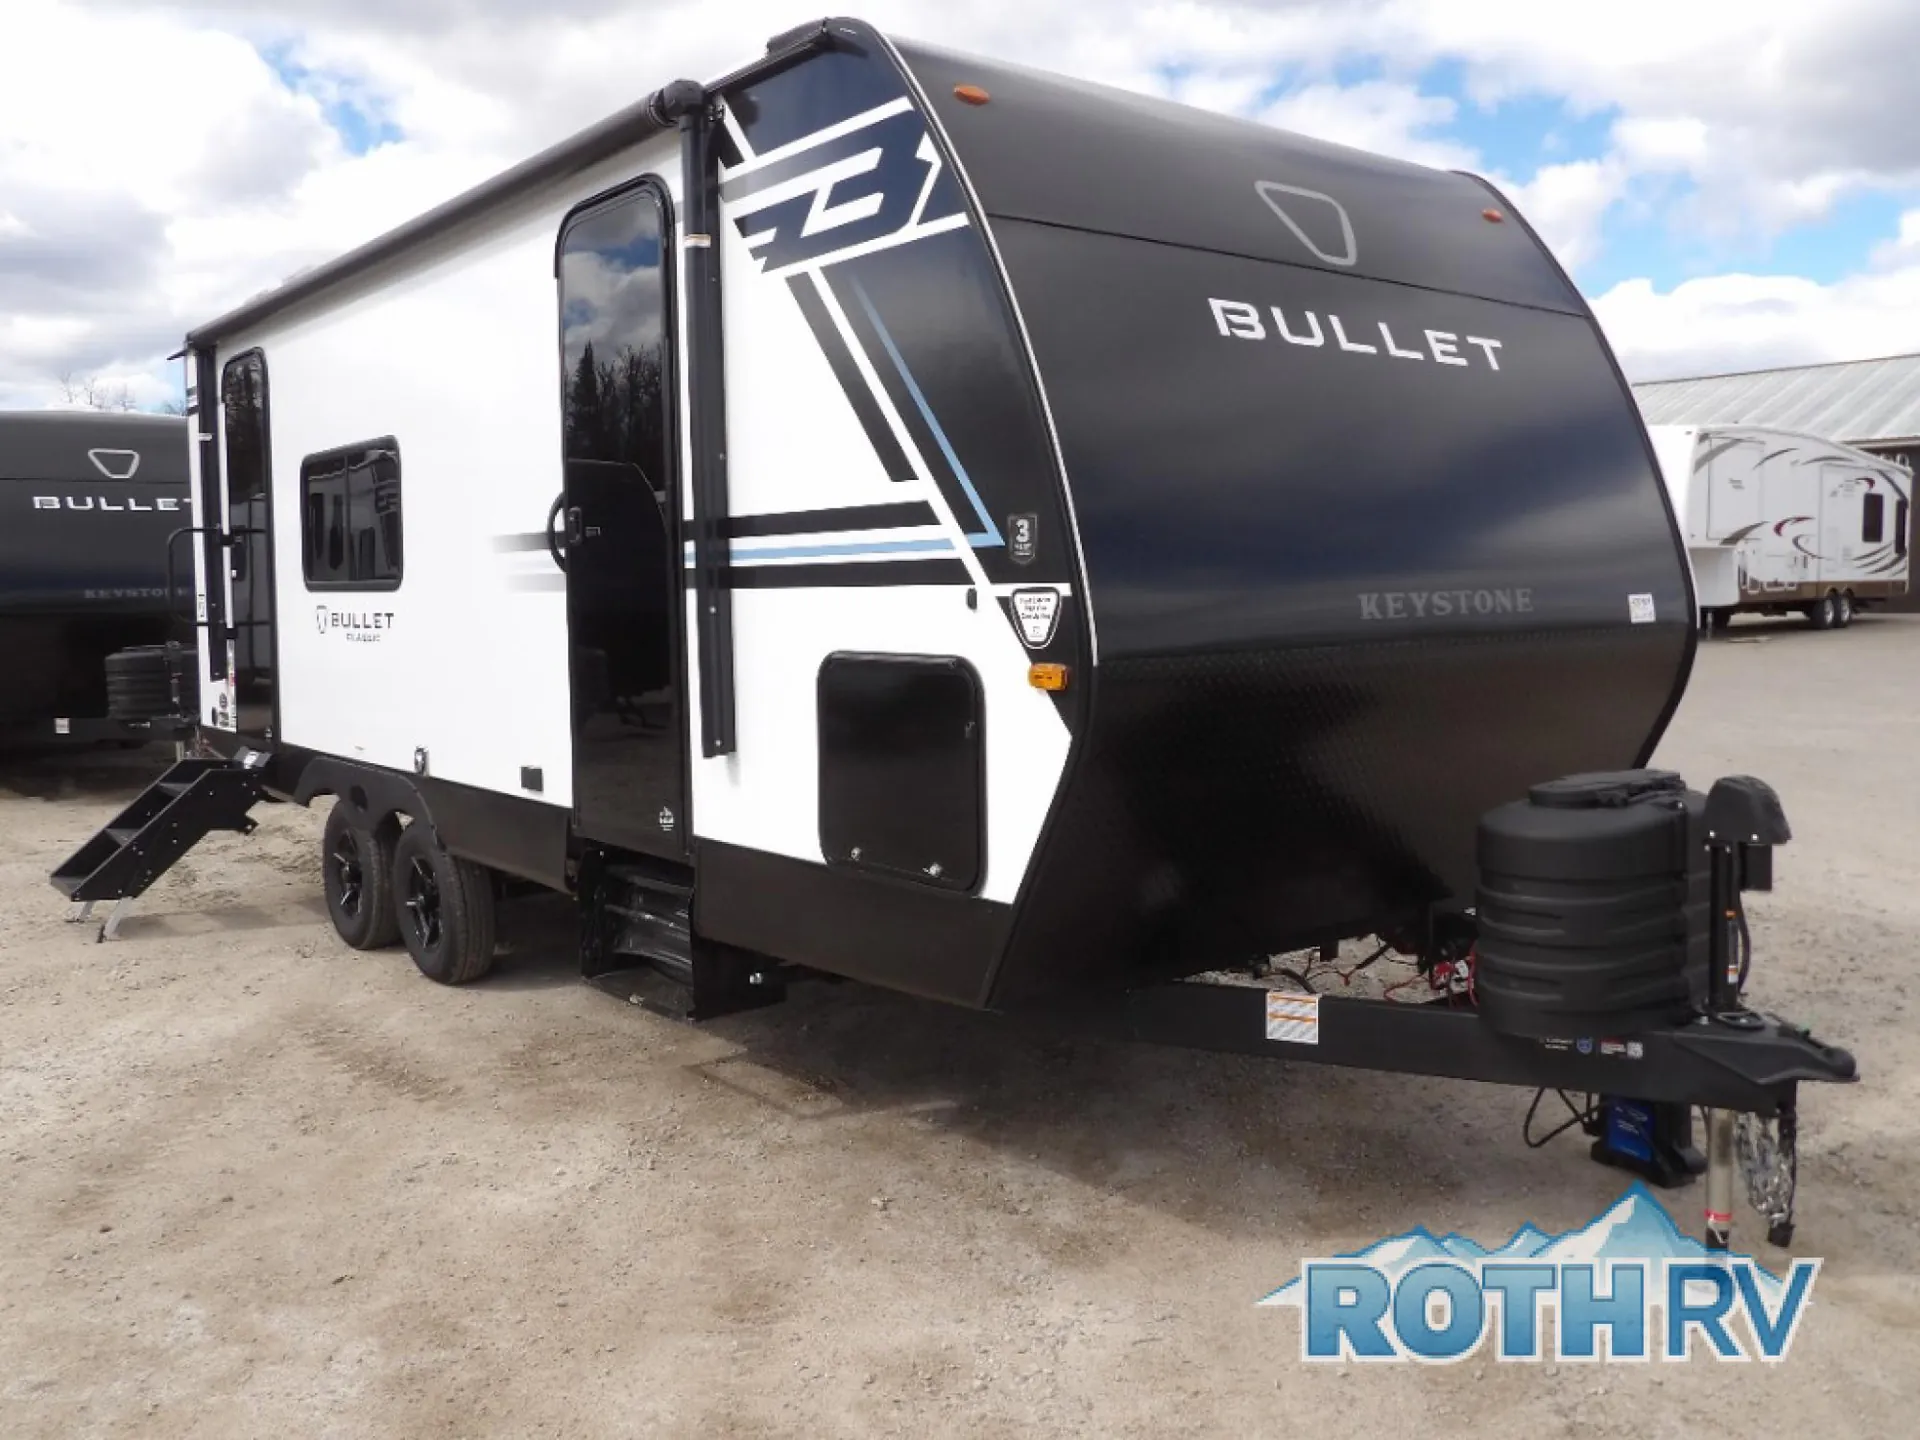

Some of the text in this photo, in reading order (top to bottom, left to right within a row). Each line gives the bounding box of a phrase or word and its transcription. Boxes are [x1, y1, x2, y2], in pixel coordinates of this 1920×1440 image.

[1207, 297, 1503, 371] BULLET
[32, 495, 192, 512] BULLE
[1015, 518, 1030, 543] 3
[1358, 588, 1534, 620] KEYSTONE
[331, 612, 395, 629] BULLET
